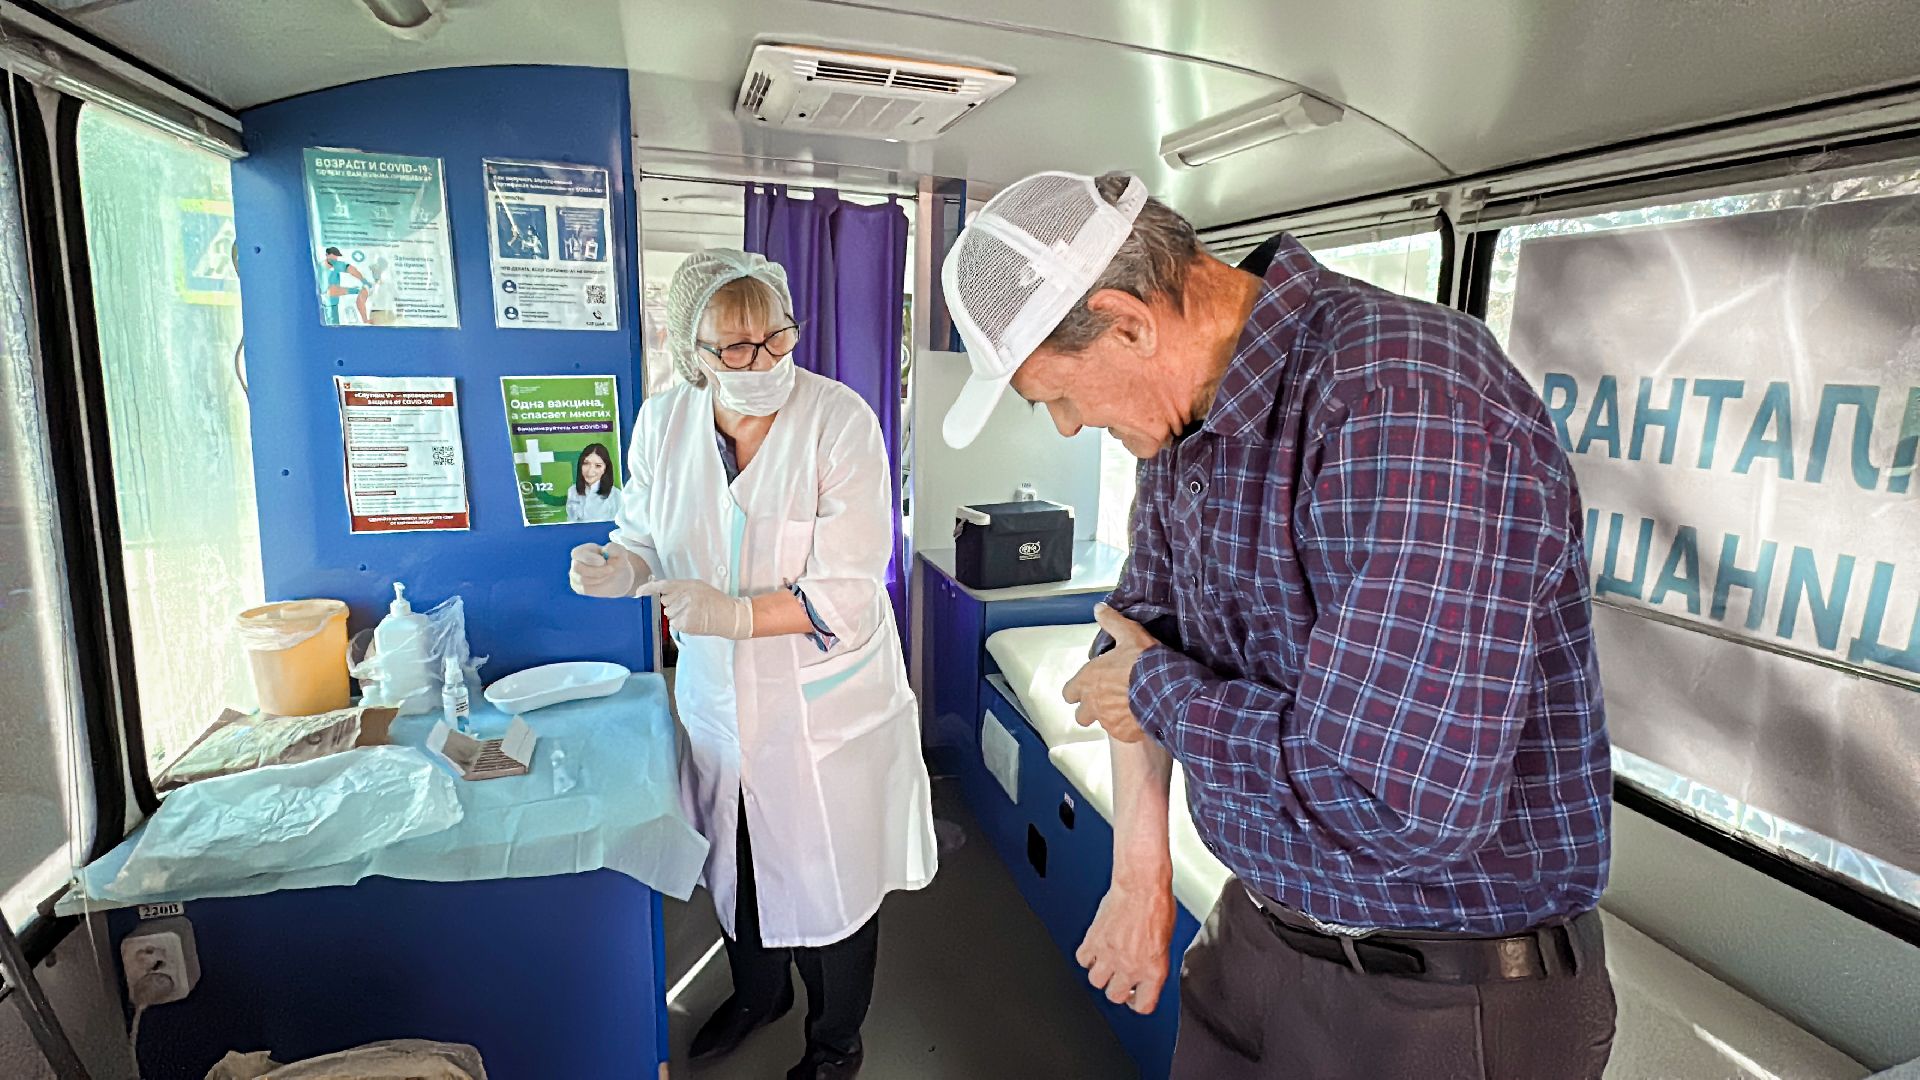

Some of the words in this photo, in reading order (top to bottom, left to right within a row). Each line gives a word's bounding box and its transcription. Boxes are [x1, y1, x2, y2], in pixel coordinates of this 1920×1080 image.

[315, 158, 367, 170] ВОЗРАСТ
[368, 161, 377, 171] И
[510, 399, 544, 410] Одна
[547, 398, 604, 409] вакцина,
[511, 411, 519, 420] а
[521, 410, 567, 420] спасает
[569, 409, 611, 419] многих
[535, 482, 554, 491] 122
